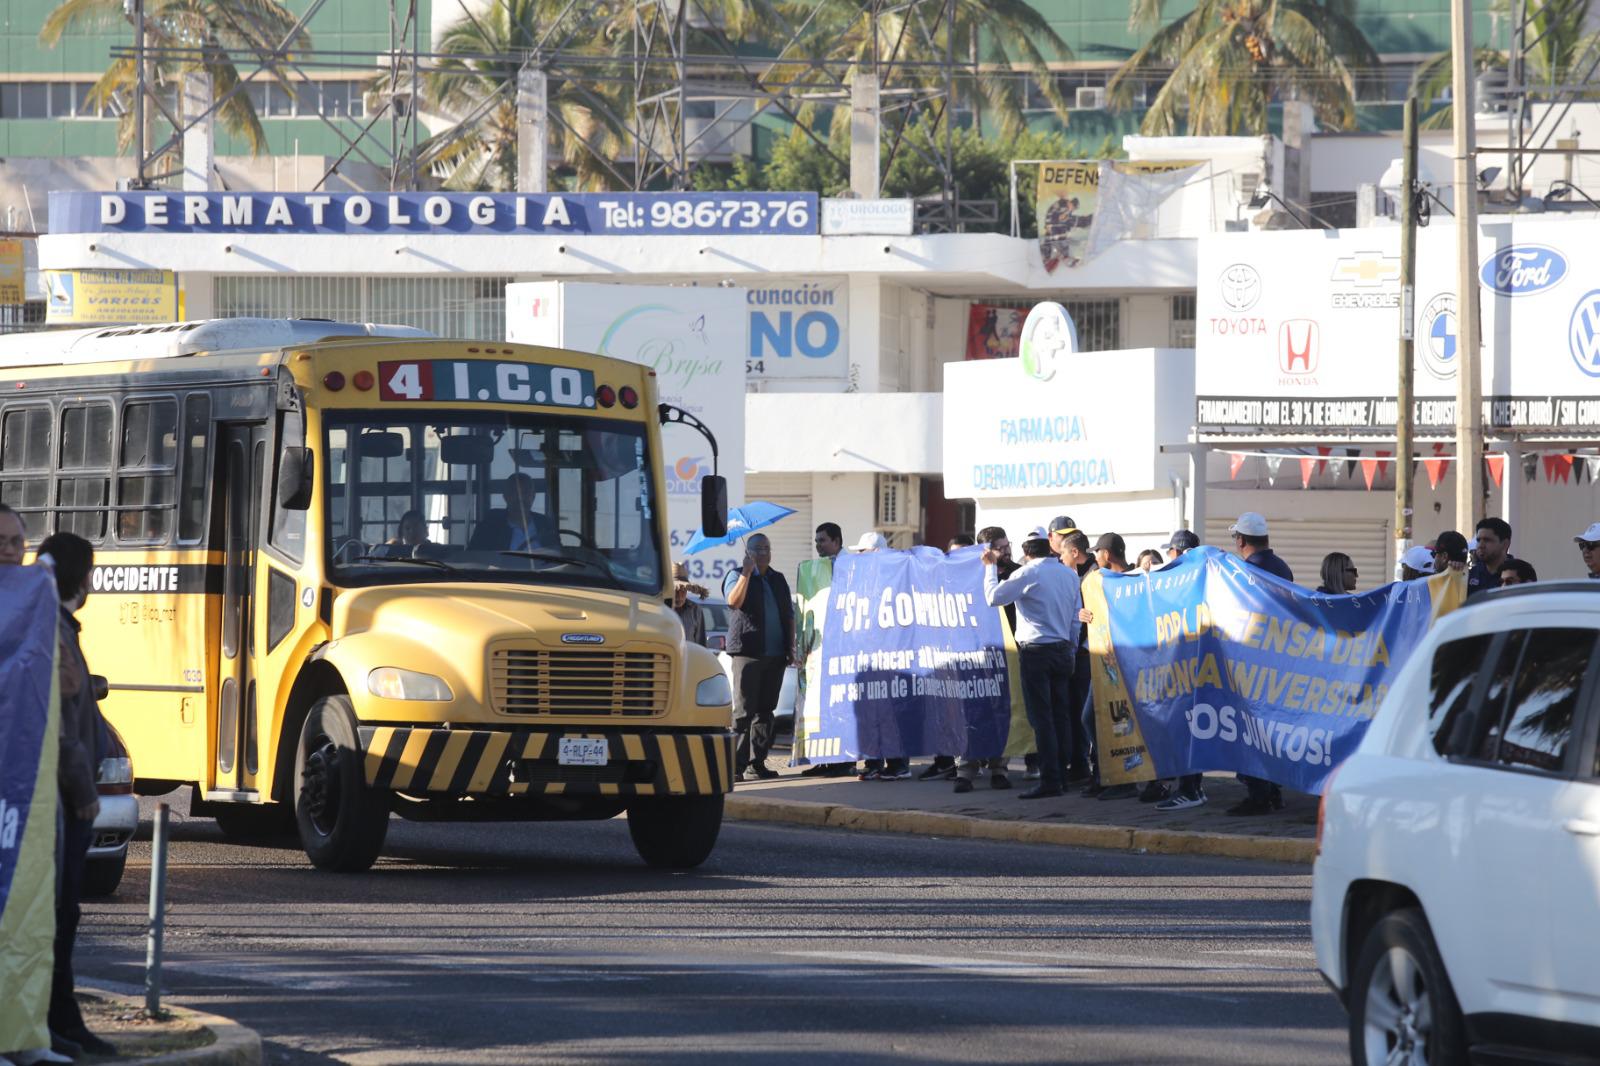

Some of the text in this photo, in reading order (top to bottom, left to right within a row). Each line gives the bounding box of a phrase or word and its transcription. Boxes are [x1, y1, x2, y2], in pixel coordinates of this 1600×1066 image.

[101, 195, 572, 225] DERMATOLOGIA
[599, 201, 644, 228] Tel:
[1495, 251, 1553, 288] Ford
[88, 297, 161, 305] VARICES
[747, 283, 834, 305] cunación
[1331, 293, 1401, 309] CHEVROLE
[750, 310, 840, 358] NO
[1210, 318, 1267, 335] TOYOTA
[745, 360, 765, 373] 54
[388, 364, 423, 399] 4
[1278, 377, 1319, 386] HONDA
[1493, 400, 1527, 425] CHECAR
[1528, 395, 1553, 425] BURÓ
[999, 416, 1085, 443] FARMACIA
[972, 460, 1113, 489] DERMATOLOGICA
[92, 566, 179, 591] OCCIDENTE
[867, 680, 888, 700] una
[891, 674, 908, 699] de
